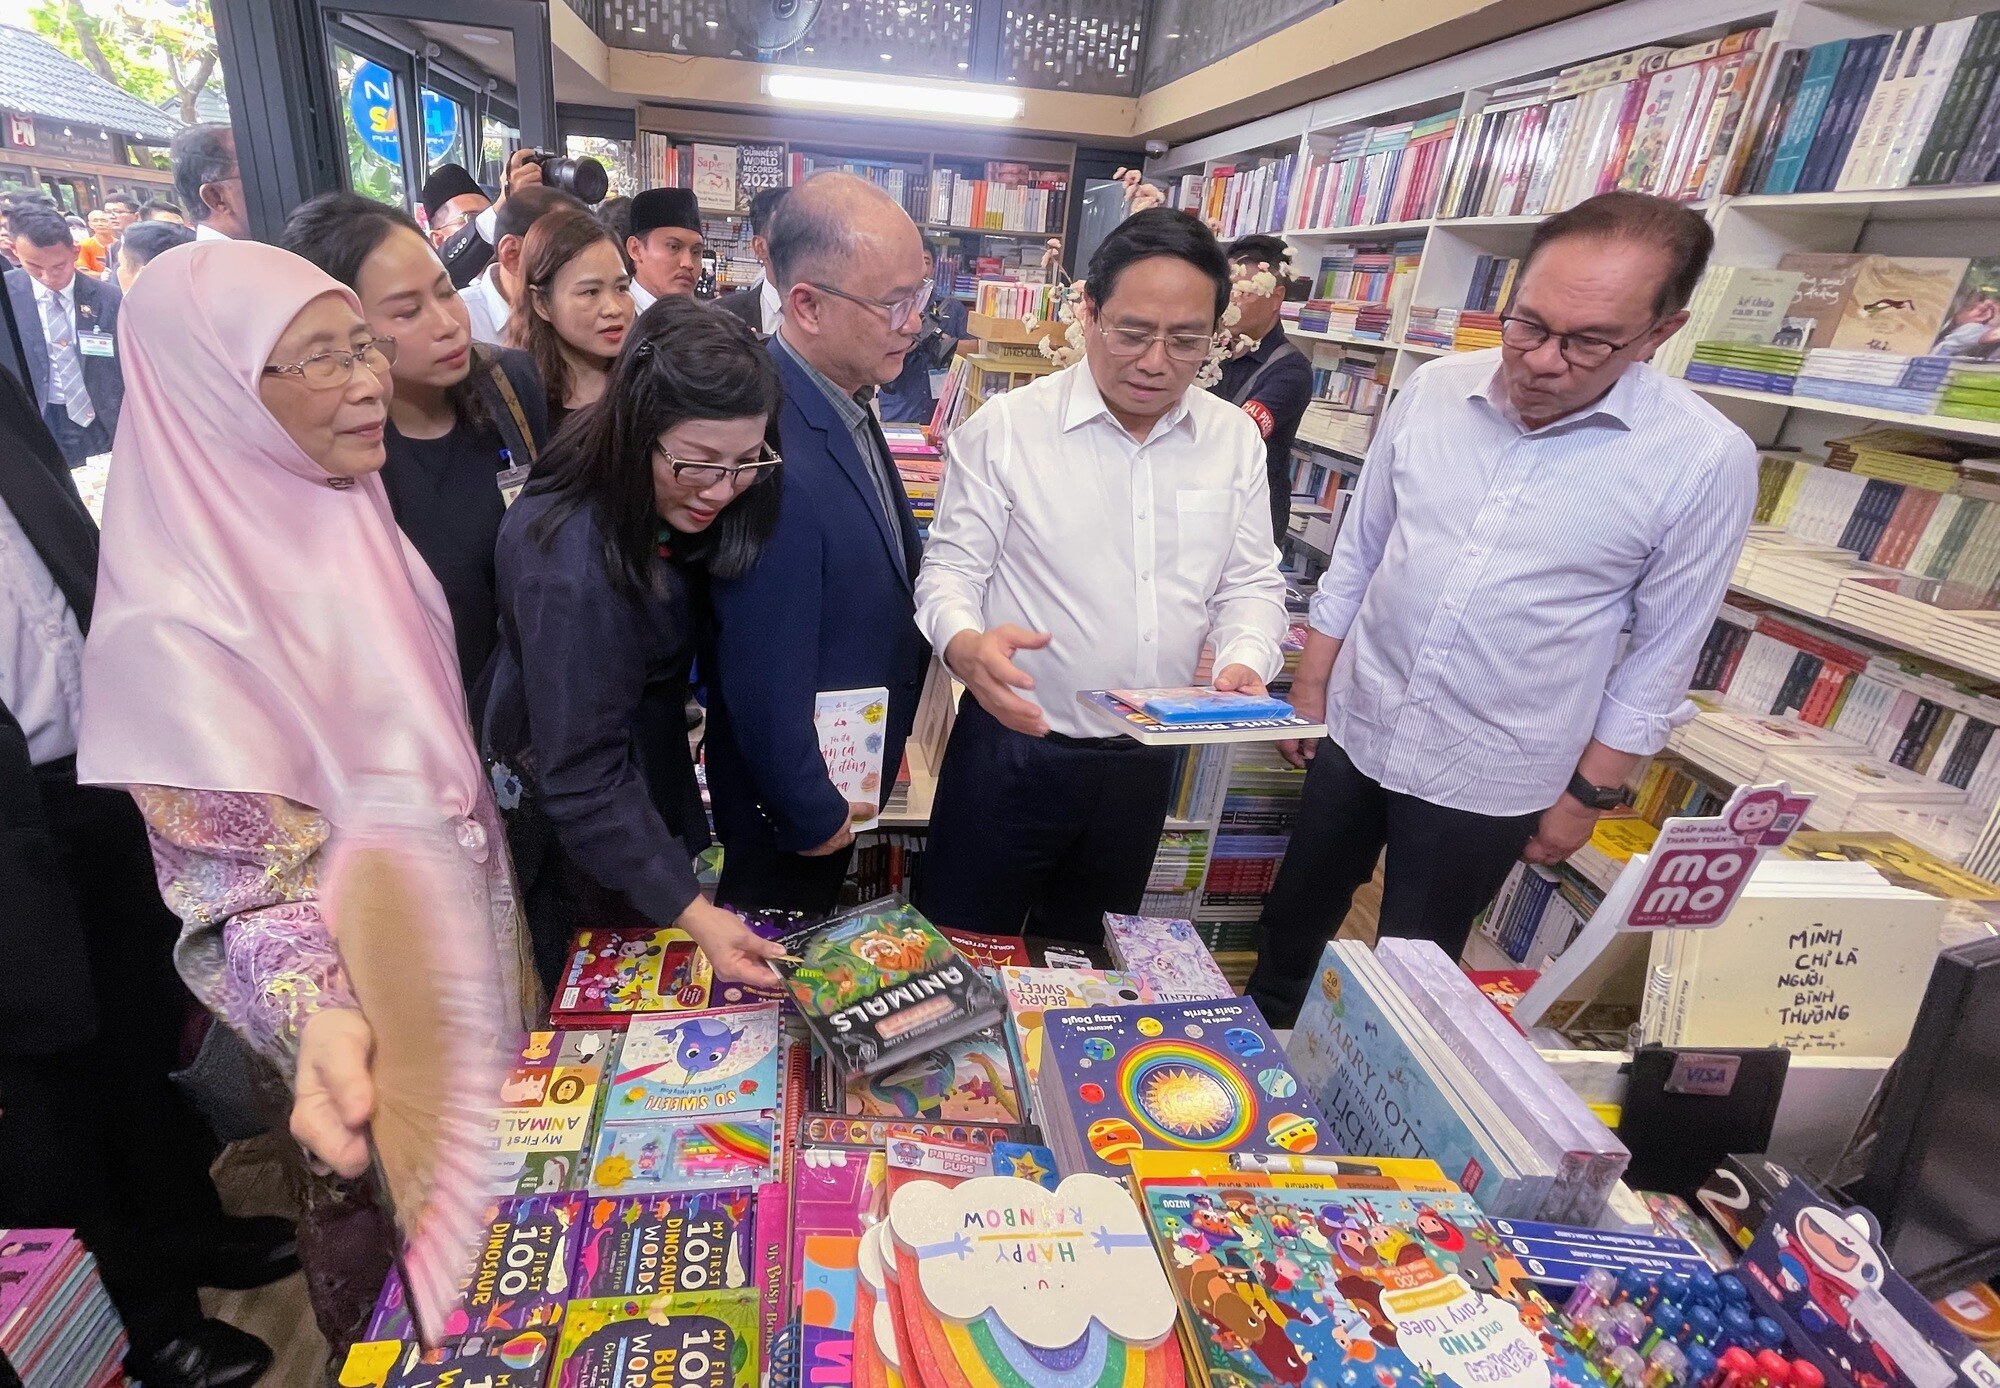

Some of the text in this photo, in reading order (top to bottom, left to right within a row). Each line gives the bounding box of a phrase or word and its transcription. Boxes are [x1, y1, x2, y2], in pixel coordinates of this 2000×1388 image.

[743, 149, 778, 158] GUINNESS
[743, 157, 778, 166] WORLD
[743, 165, 777, 174] RECORDS
[743, 173, 778, 187] 2023
[828, 966, 964, 1033] ANIMALS
[1016, 982, 1065, 995] SWEET
[1019, 994, 1068, 1006] BEARY
[1061, 1013, 1123, 1025] Lizzy Doyle
[1182, 1005, 1243, 1019] Chris Ferrie
[645, 1090, 737, 1111] SO SWEET!
[1374, 1083, 1430, 1159] POTT
[506, 1133, 563, 1146] My First
[928, 1148, 987, 1167] PAWSOME
[943, 1160, 975, 1174] PUPS
[1284, 1181, 1325, 1191] Adventure
[1163, 1199, 1191, 1209] AUZOU
[471, 1223, 511, 1306] DINOSAUR
[498, 1225, 539, 1296] 100
[528, 1226, 553, 1292] MY FIRST
[613, 1232, 631, 1290] Chris Ferrie
[635, 1225, 662, 1295] WORDS
[657, 1218, 683, 1295] DINOSAUR
[680, 1222, 711, 1290] 100
[709, 1221, 724, 1286] MY FIRST
[995, 1242, 1075, 1263] HAPPY
[1394, 1275, 1418, 1287] 200
[764, 1244, 782, 1354] My Busy Books
[1447, 1291, 1489, 1325] Fairy
[1399, 1315, 1453, 1337] Tales
[1439, 1320, 1503, 1356] and FIND
[601, 1342, 617, 1373] Chris
[625, 1333, 653, 1388] WOR
[650, 1348, 677, 1388] BU
[711, 1329, 726, 1388] MY FIR
[1465, 1338, 1538, 1382] SEARCH
